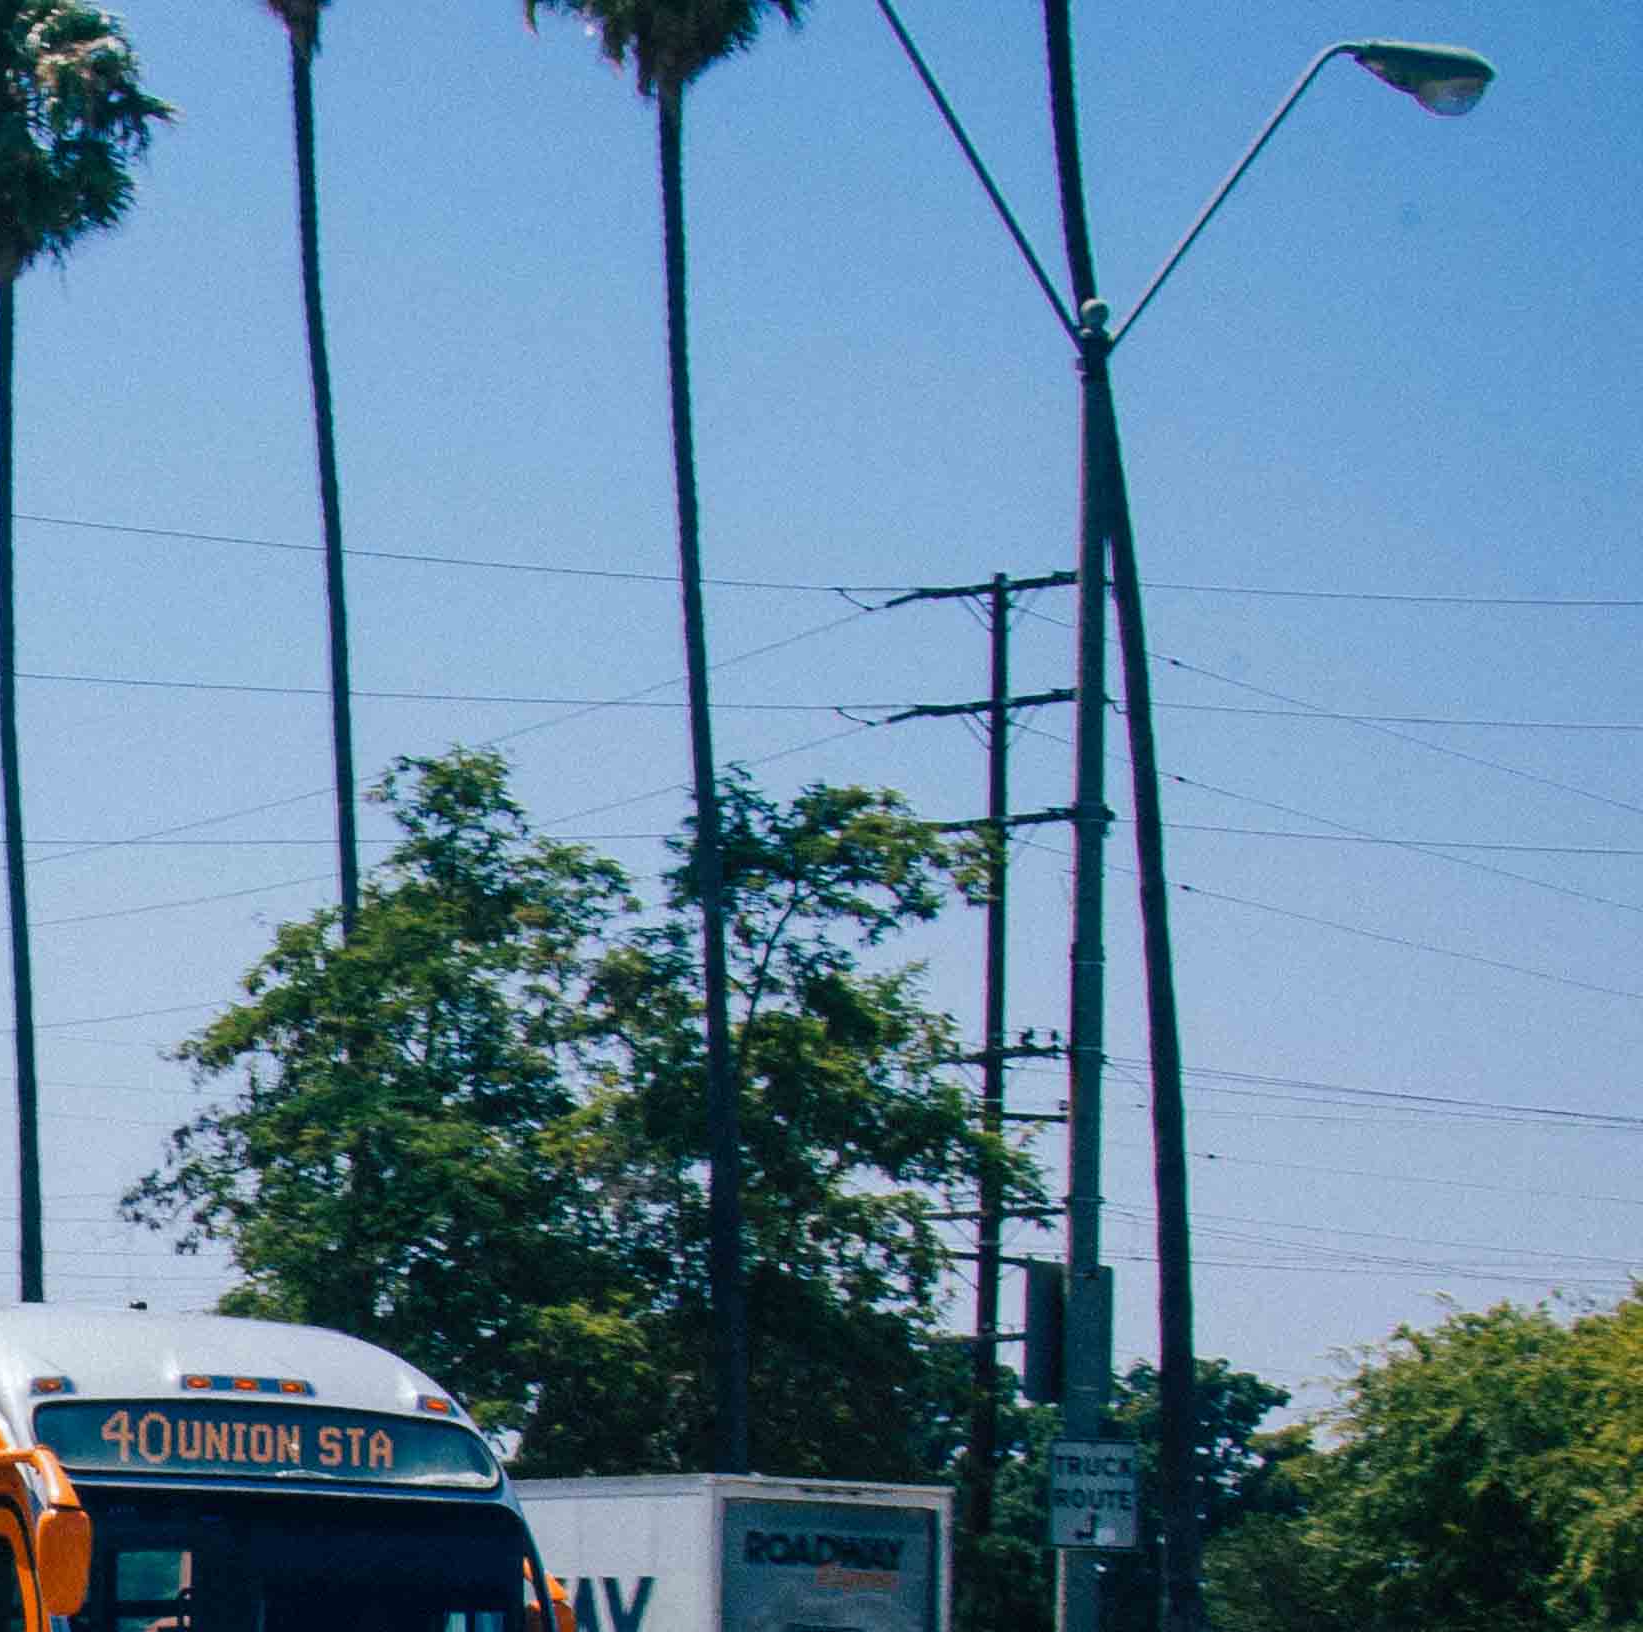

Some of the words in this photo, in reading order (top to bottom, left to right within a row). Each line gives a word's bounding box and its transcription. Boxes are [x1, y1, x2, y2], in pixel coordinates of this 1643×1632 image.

[101, 1409, 171, 1465] 40
[178, 1419, 300, 1465] UNION
[317, 1427, 394, 1469] STA
[1055, 1455, 1133, 1476] TRUCK
[1054, 1487, 1132, 1510] ROUTE
[746, 1530, 904, 1570] ROADWAY
